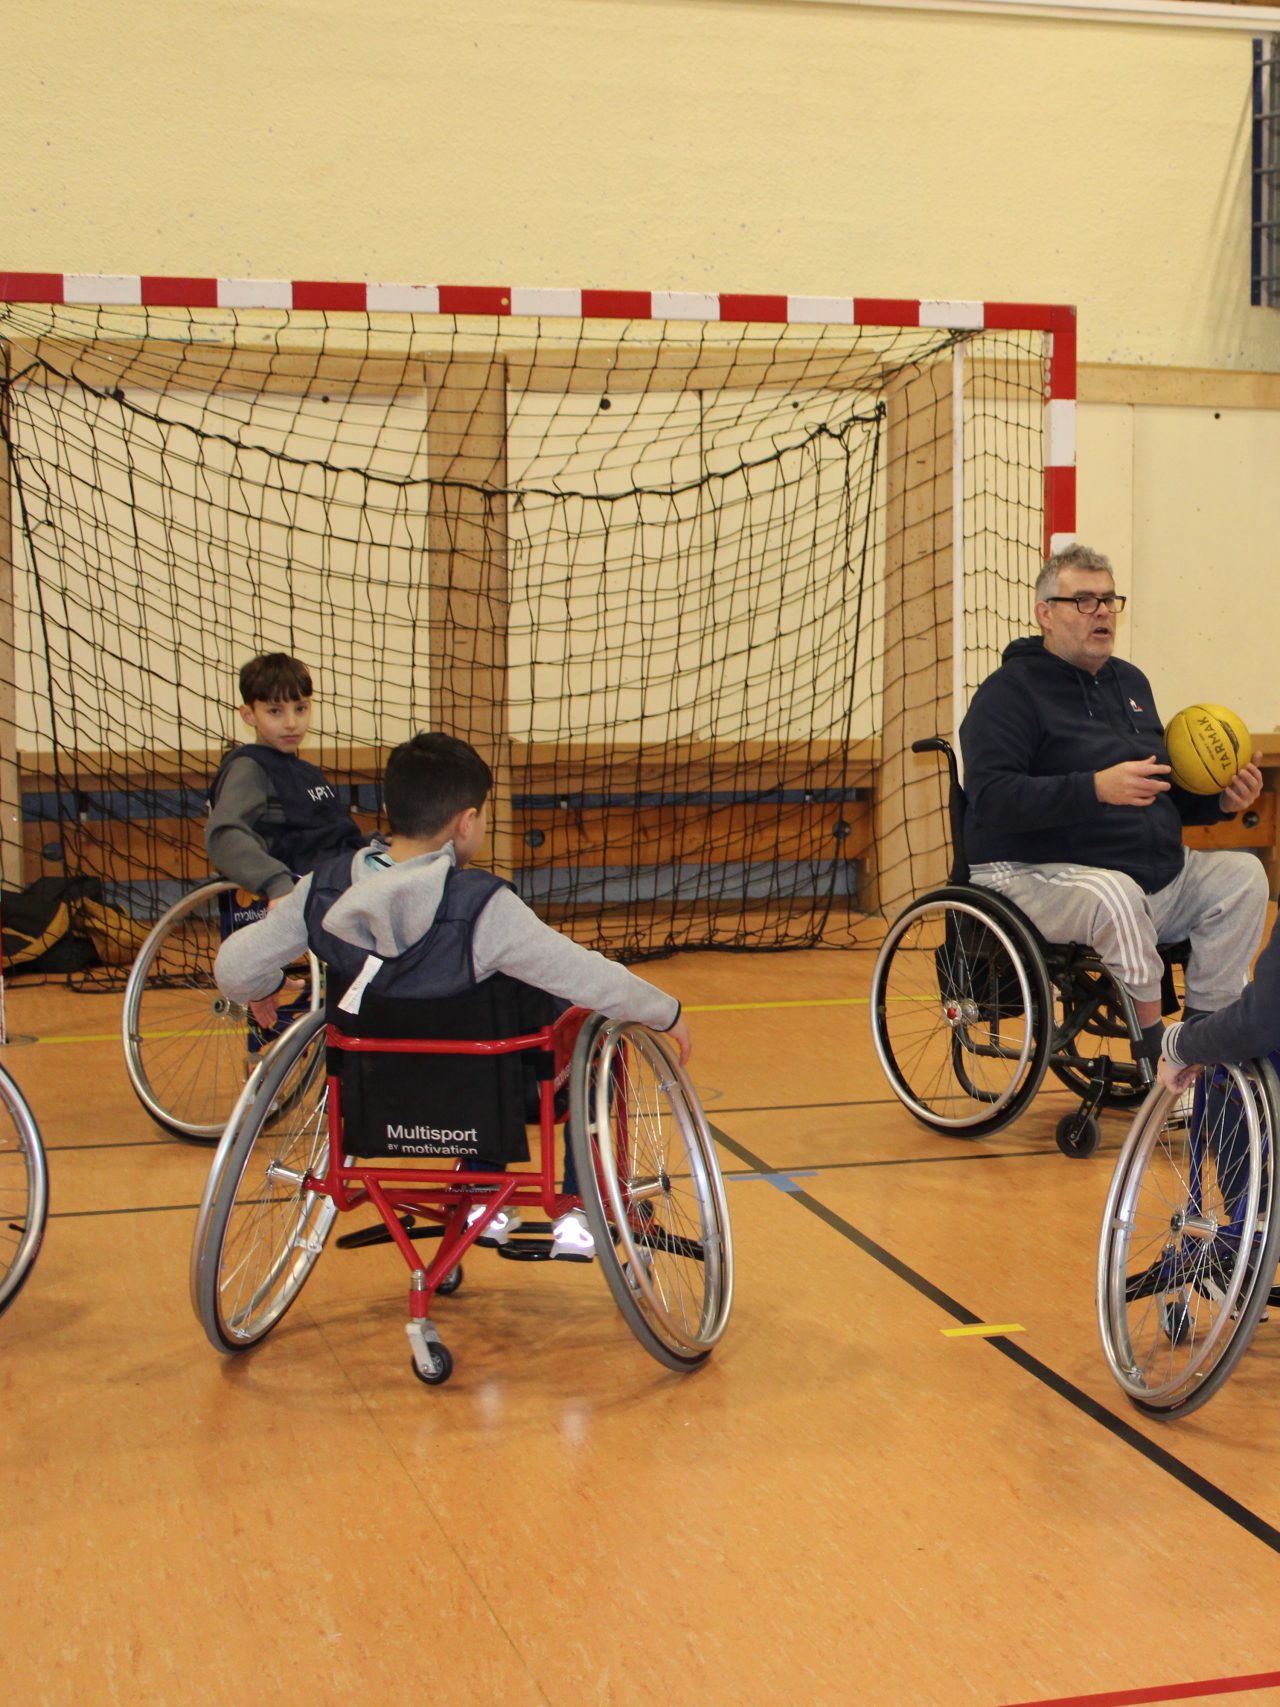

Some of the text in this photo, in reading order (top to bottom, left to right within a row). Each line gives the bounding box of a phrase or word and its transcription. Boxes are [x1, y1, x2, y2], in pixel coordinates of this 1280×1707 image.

[1197, 716, 1232, 771] TARMAK
[386, 1124, 478, 1144] Multisport
[387, 1143, 479, 1155] BY motivation
